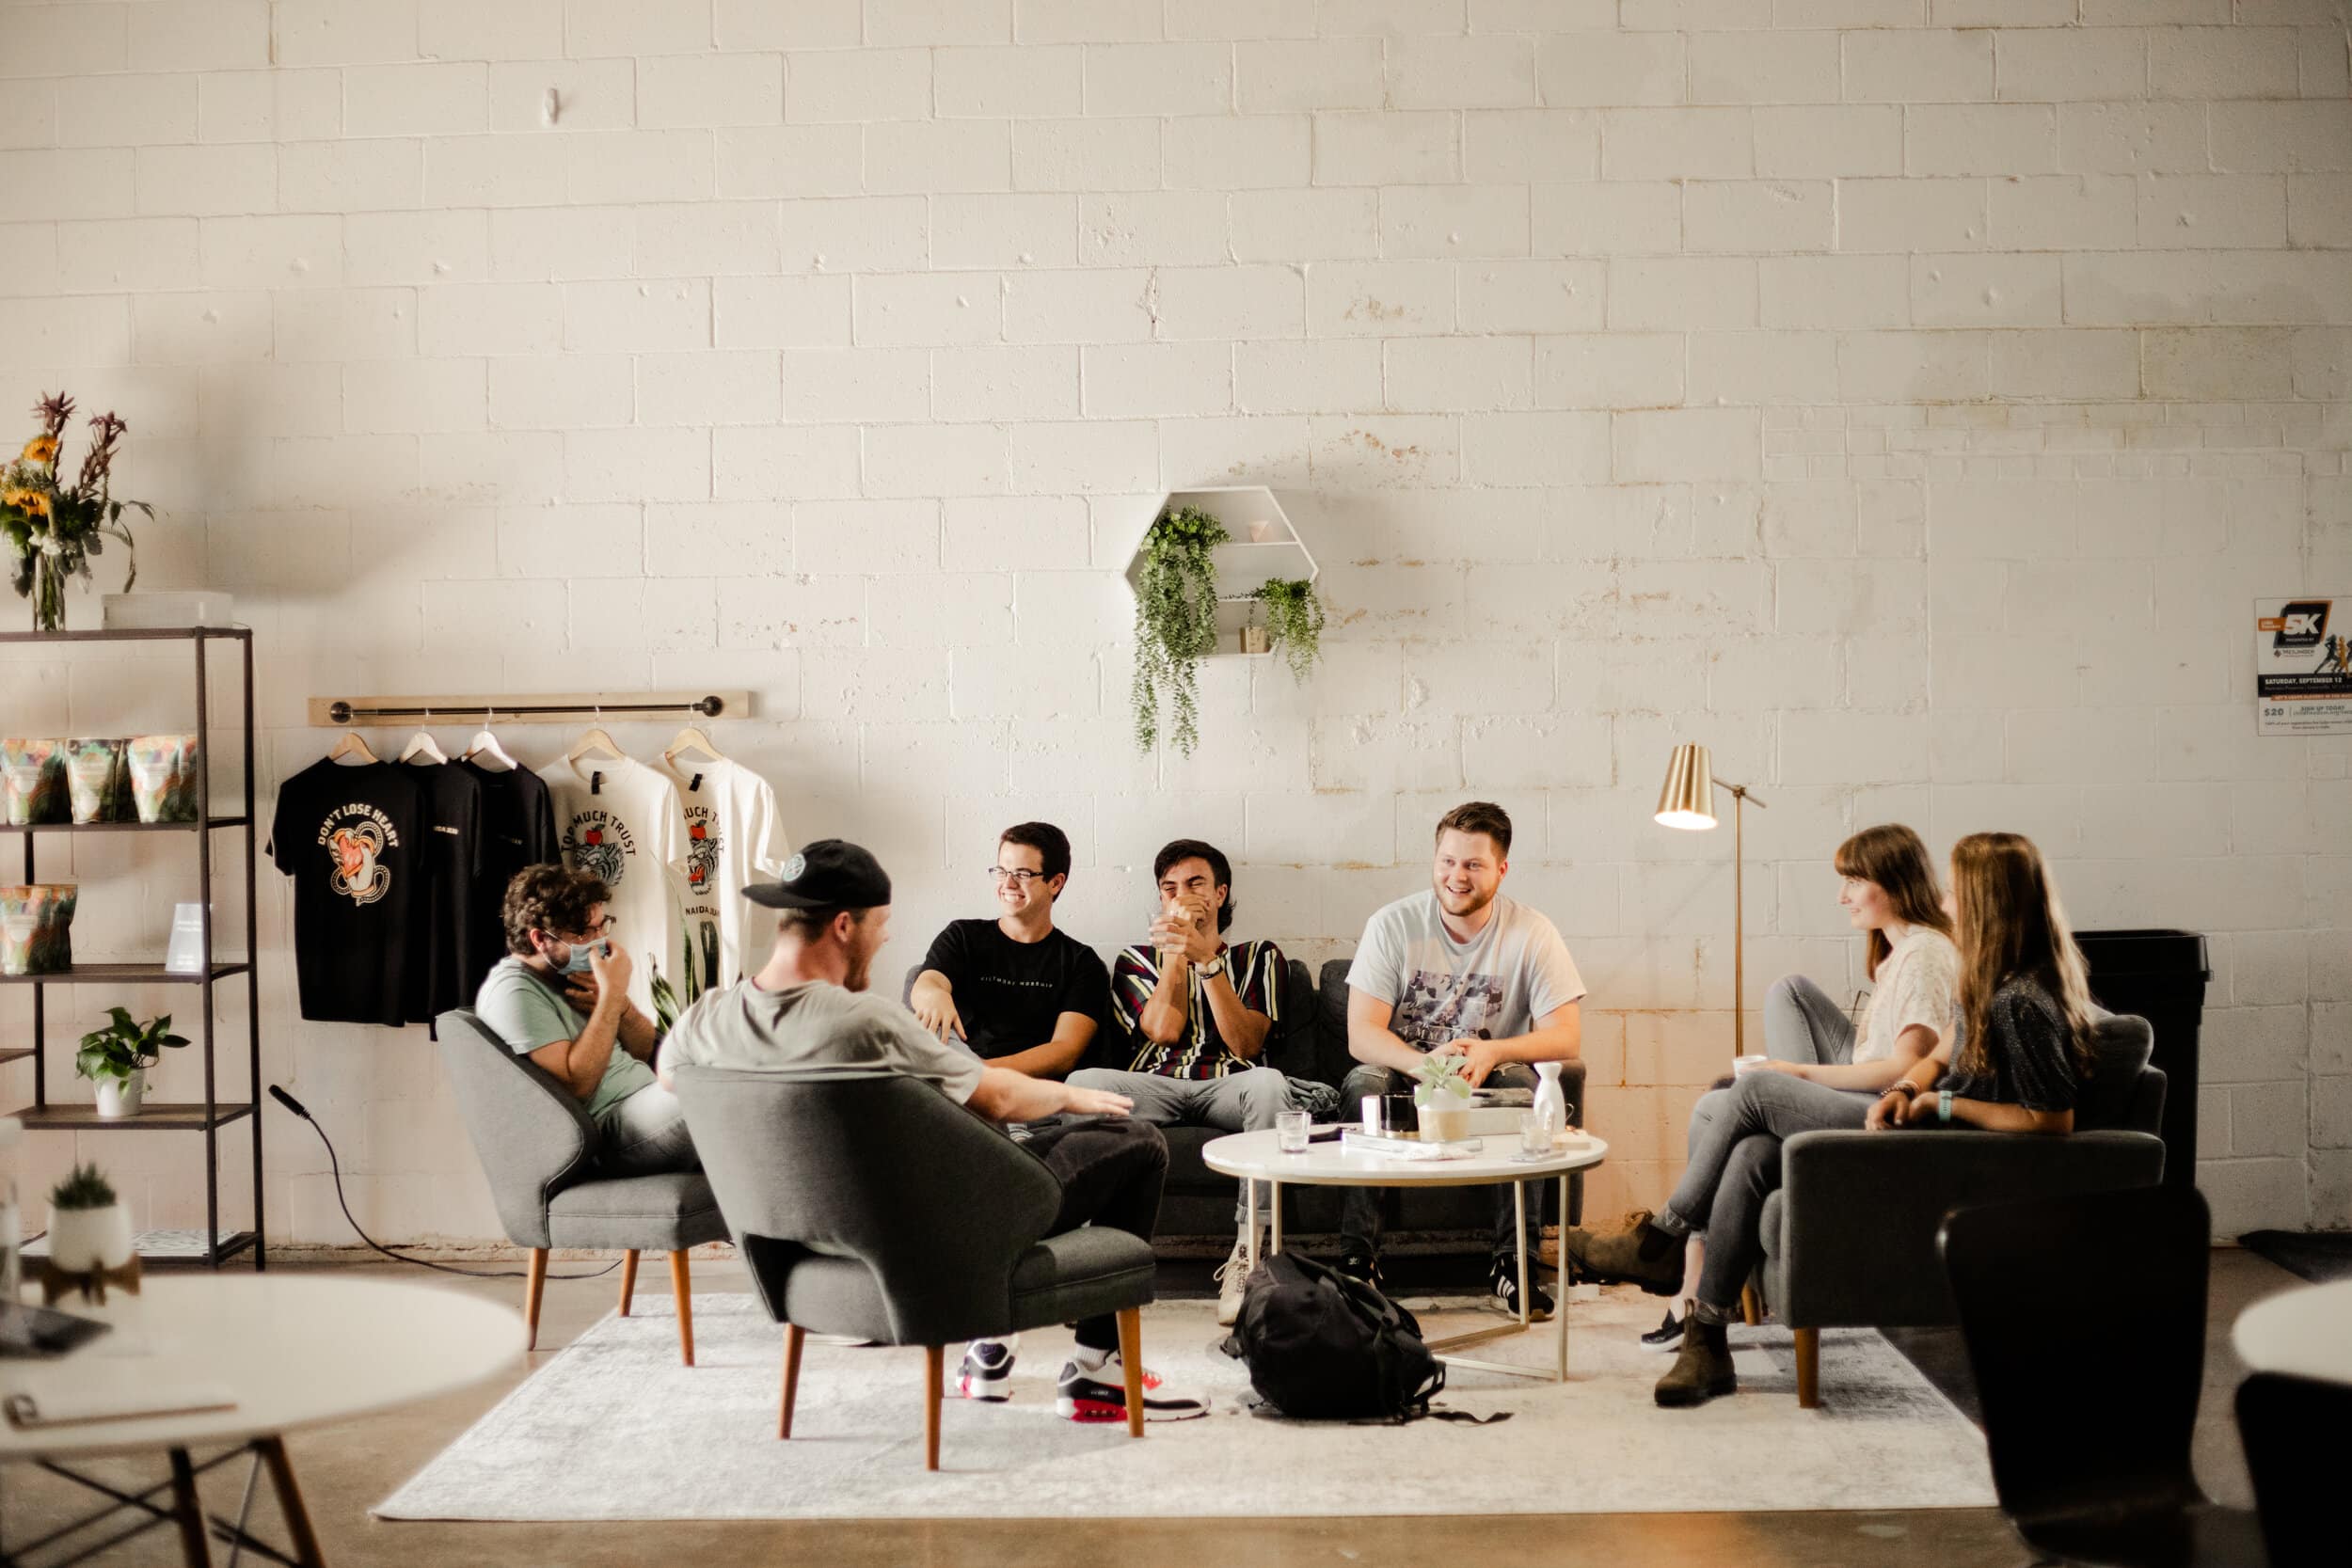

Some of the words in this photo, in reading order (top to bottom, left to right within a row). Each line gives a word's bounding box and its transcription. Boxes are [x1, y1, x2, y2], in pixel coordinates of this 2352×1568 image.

[2283, 613, 2322, 635] 5K
[2265, 707, 2284, 717] $20
[684, 806, 708, 820] UCH
[318, 809, 342, 847] DON'T
[342, 803, 373, 816] LOSE
[372, 809, 399, 847] HEART
[573, 810, 608, 828] MUCH
[610, 816, 637, 856] TRUST
